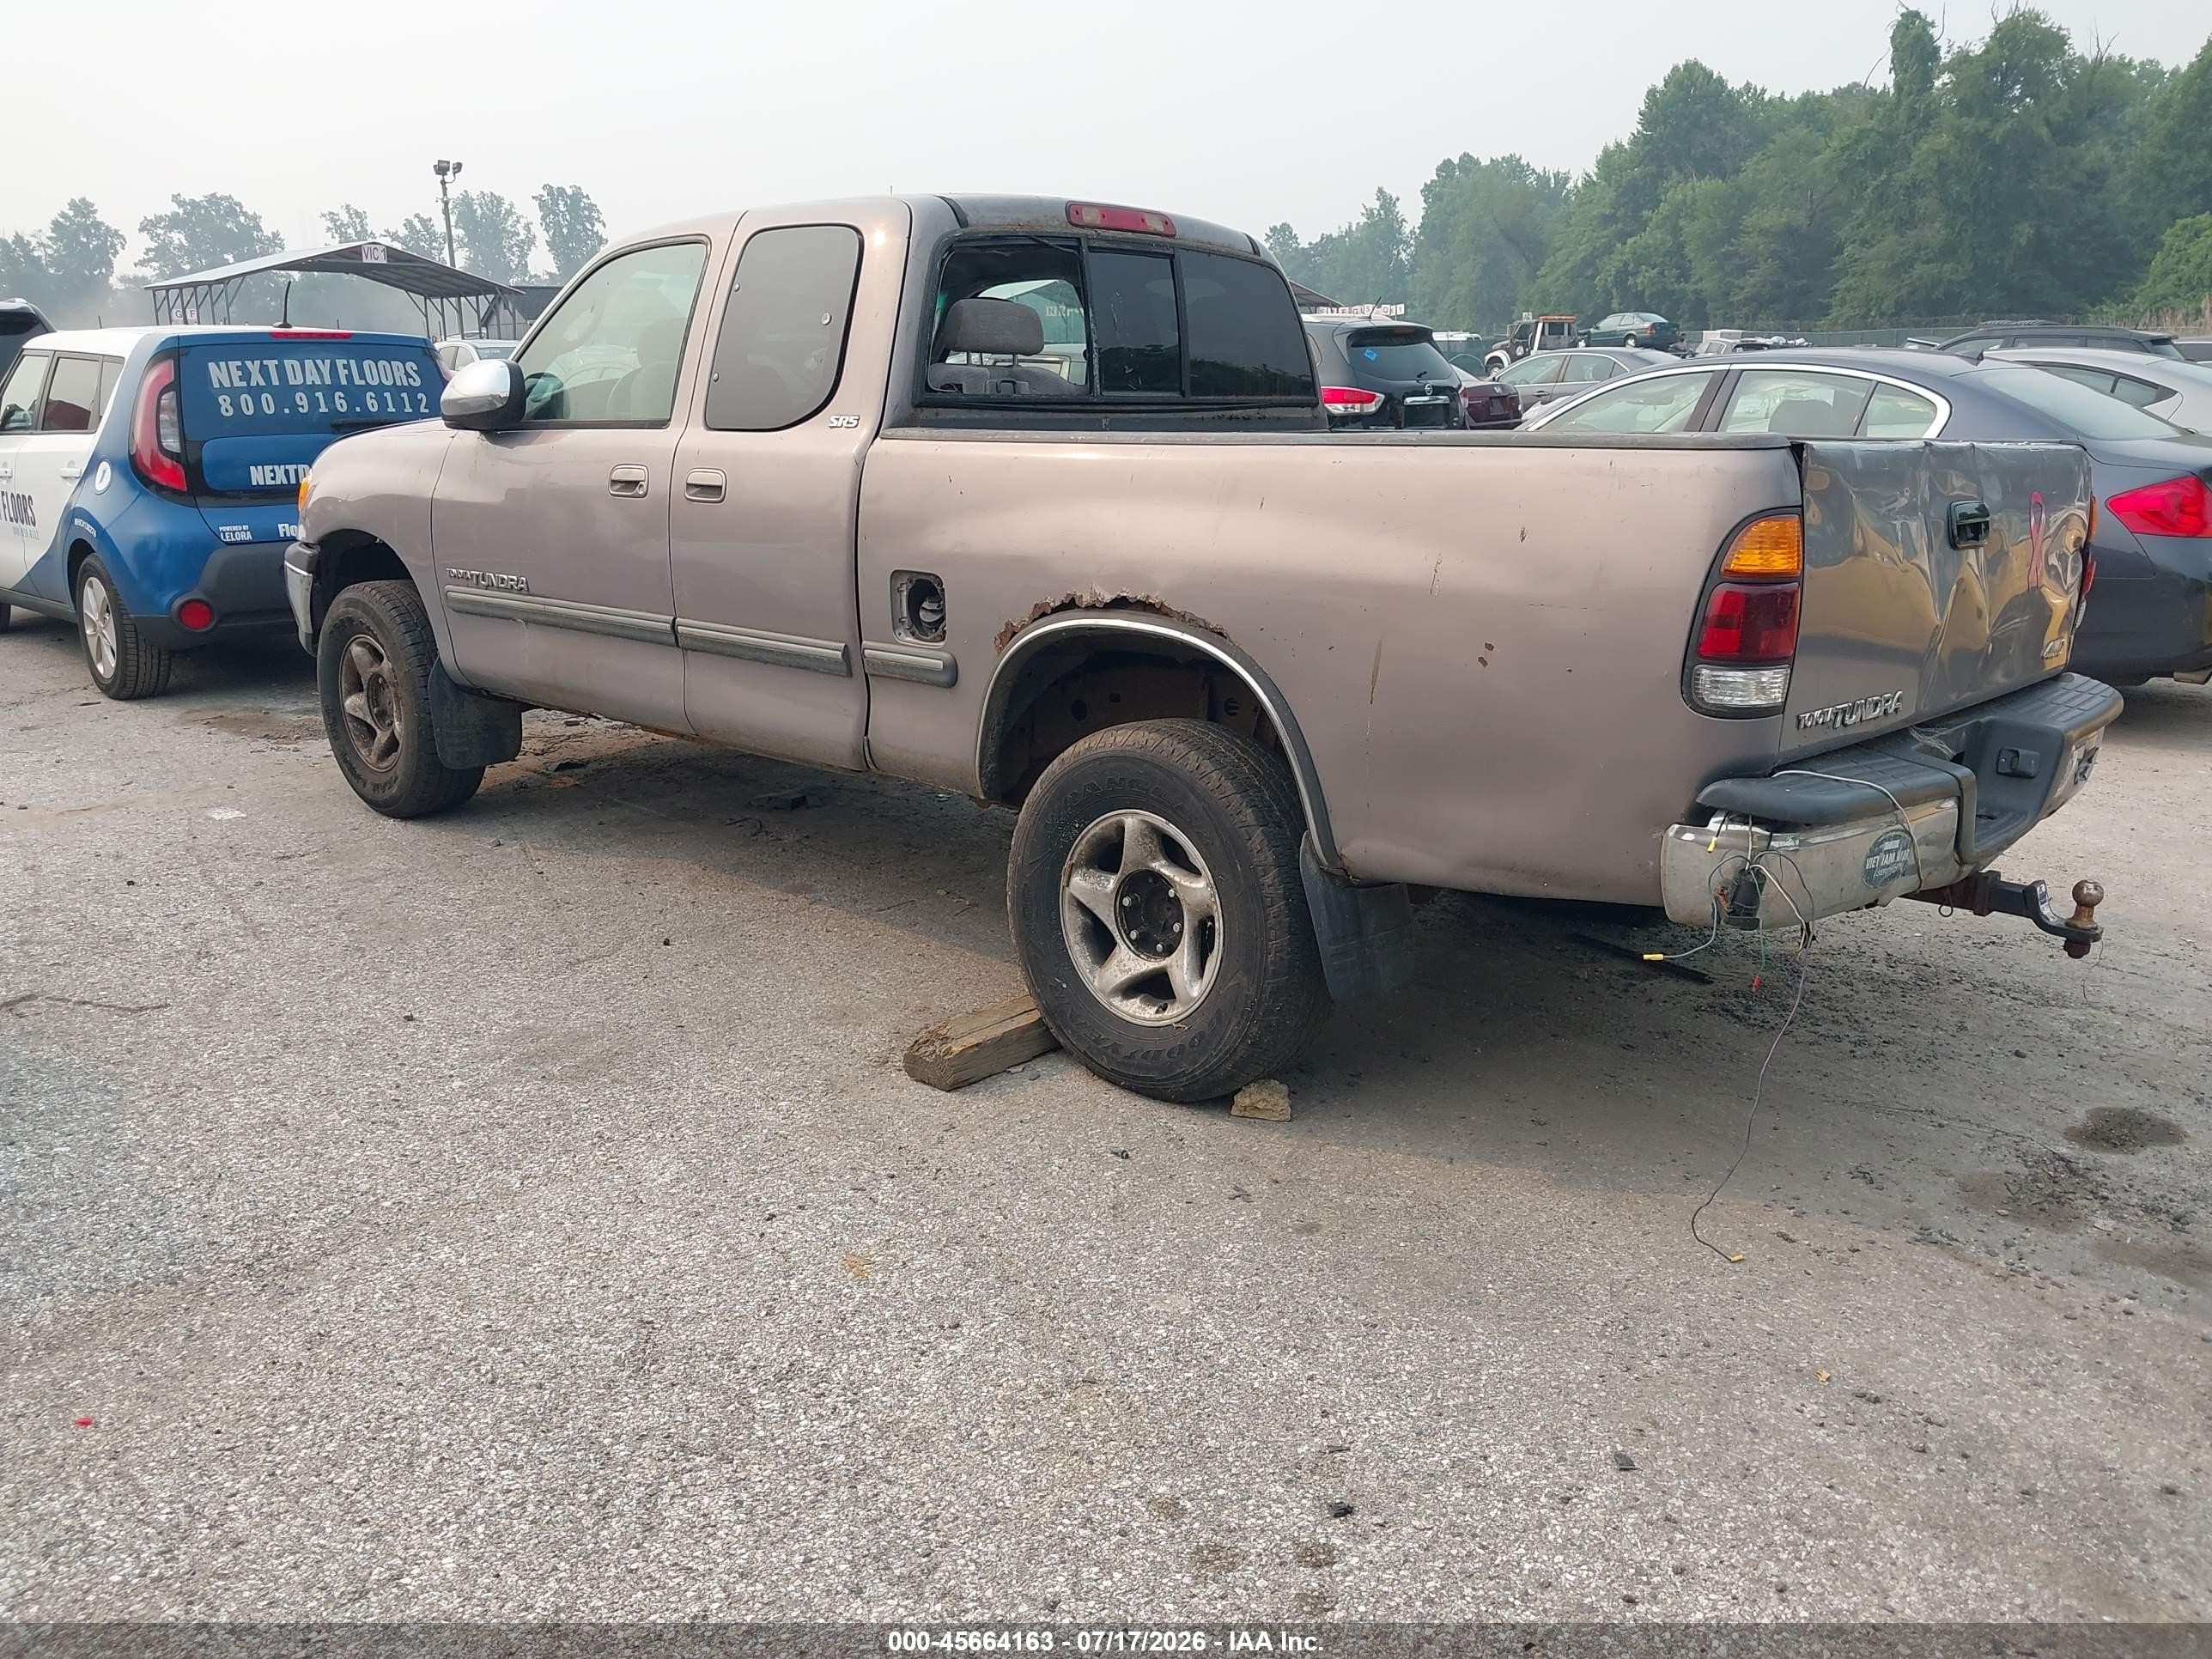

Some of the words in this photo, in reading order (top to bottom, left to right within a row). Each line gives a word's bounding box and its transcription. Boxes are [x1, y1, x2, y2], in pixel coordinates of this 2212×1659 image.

[362, 246, 379, 261] VIC
[380, 247, 386, 261] 1
[175, 310, 183, 319] G
[207, 359, 279, 388] NEXT
[283, 359, 331, 386] DAY
[336, 359, 422, 387] FLOORS
[218, 391, 429, 417] 800.916.6112
[829, 415, 860, 428] SR5
[1, 490, 36, 527] FLOORS
[221, 531, 252, 543] LELORA
[446, 568, 471, 579] TOYOTA
[470, 570, 529, 592] TUNDRA
[1832, 690, 1904, 729] TUNDRA
